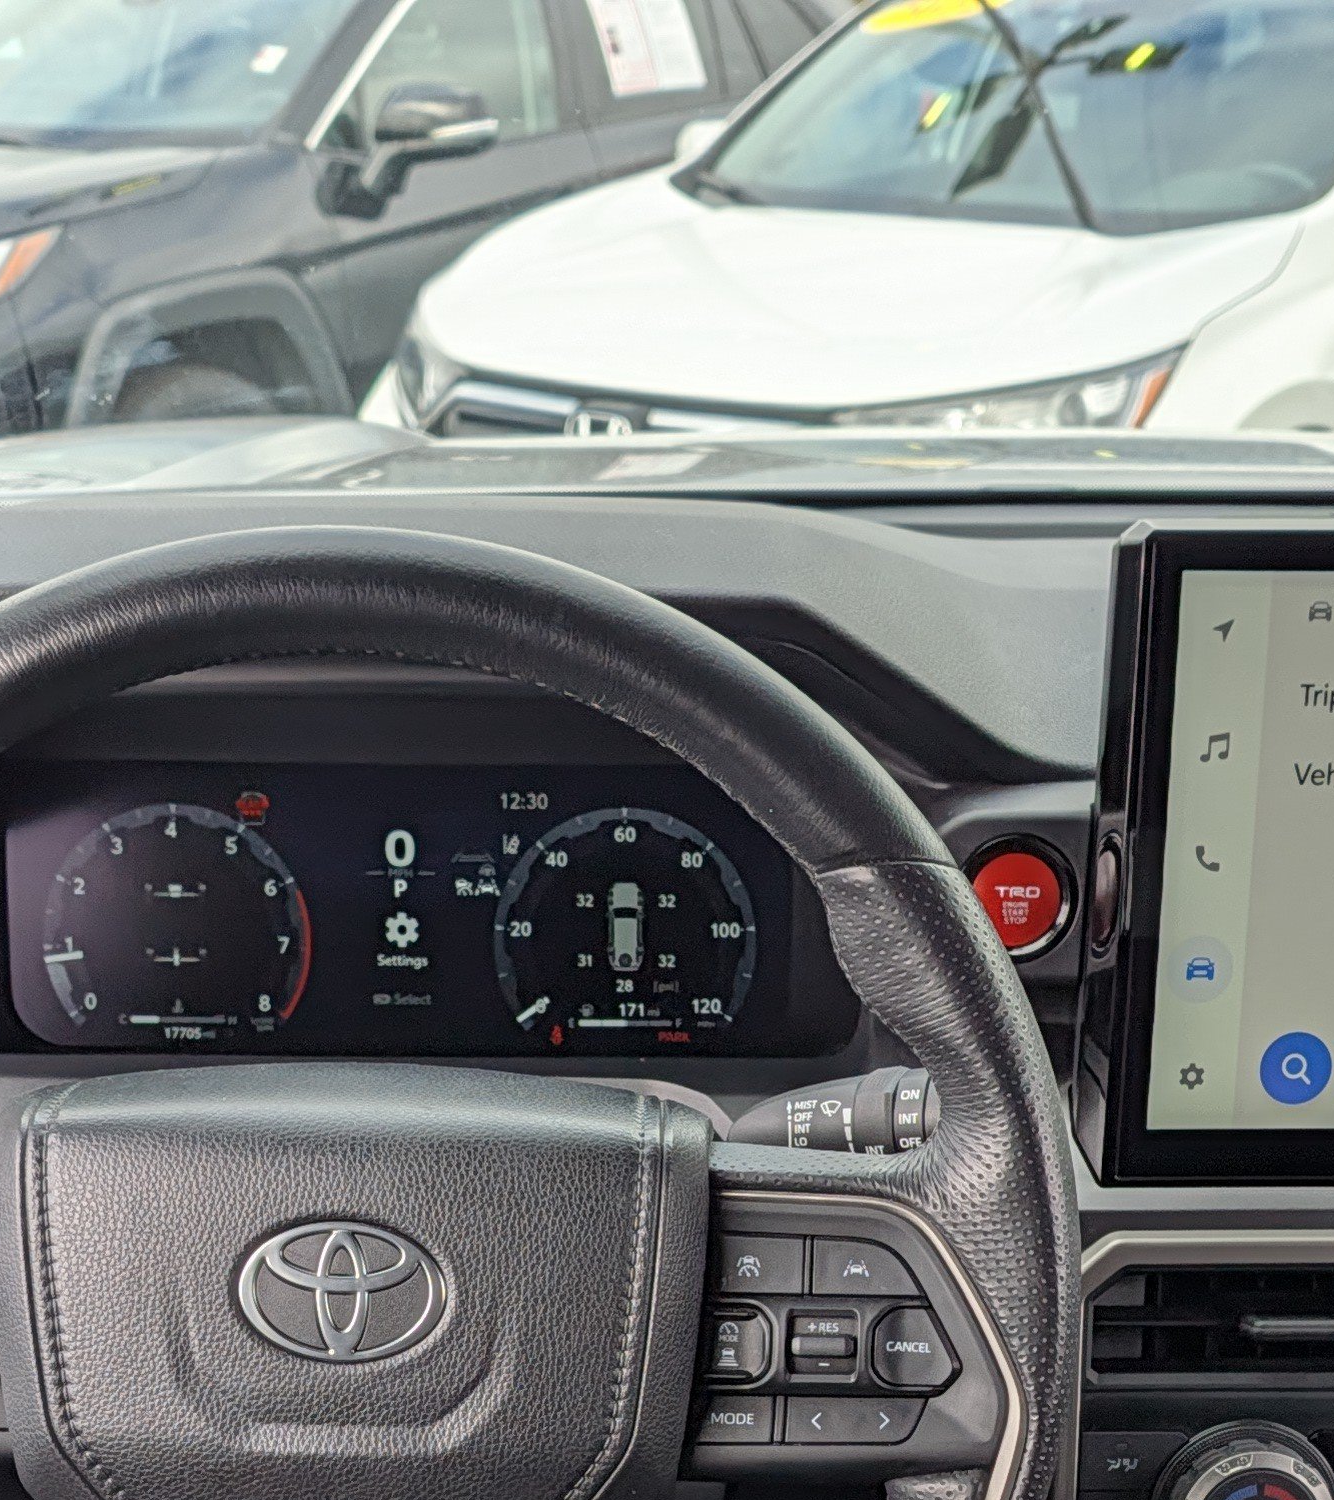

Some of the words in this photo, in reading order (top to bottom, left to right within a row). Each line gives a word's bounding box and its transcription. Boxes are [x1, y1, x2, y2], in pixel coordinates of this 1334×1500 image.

[501, 793, 549, 810] 12:30
[164, 822, 177, 838] 4
[613, 826, 637, 843] 60
[111, 836, 123, 855] 3
[225, 836, 238, 855] 5
[385, 829, 415, 867] 0
[545, 852, 568, 868] 40
[680, 852, 703, 868] 80
[73, 877, 86, 895] 2
[264, 878, 278, 897] 6
[393, 878, 408, 898] P
[994, 885, 1041, 899] TRD
[576, 894, 594, 908] 32
[658, 894, 676, 908] 32
[509, 921, 532, 938] 20
[710, 922, 741, 938] 100
[277, 935, 290, 955] 7
[376, 953, 429, 970] Settings
[577, 954, 593, 968] 31
[658, 954, 676, 968] 32
[616, 979, 634, 993] 28
[84, 992, 98, 1010] 0
[258, 994, 272, 1012] 8
[692, 998, 722, 1014] 120
[618, 1003, 645, 1017] 171
[900, 1088, 921, 1101] ON
[794, 1099, 818, 1111] MIST
[794, 1112, 813, 1123] OFF
[898, 1113, 919, 1125] INT
[794, 1123, 811, 1135] INT
[794, 1137, 808, 1147] LO
[898, 1137, 922, 1149] OFF
[886, 1341, 931, 1354] CANCEL
[710, 1412, 755, 1426] MODE
